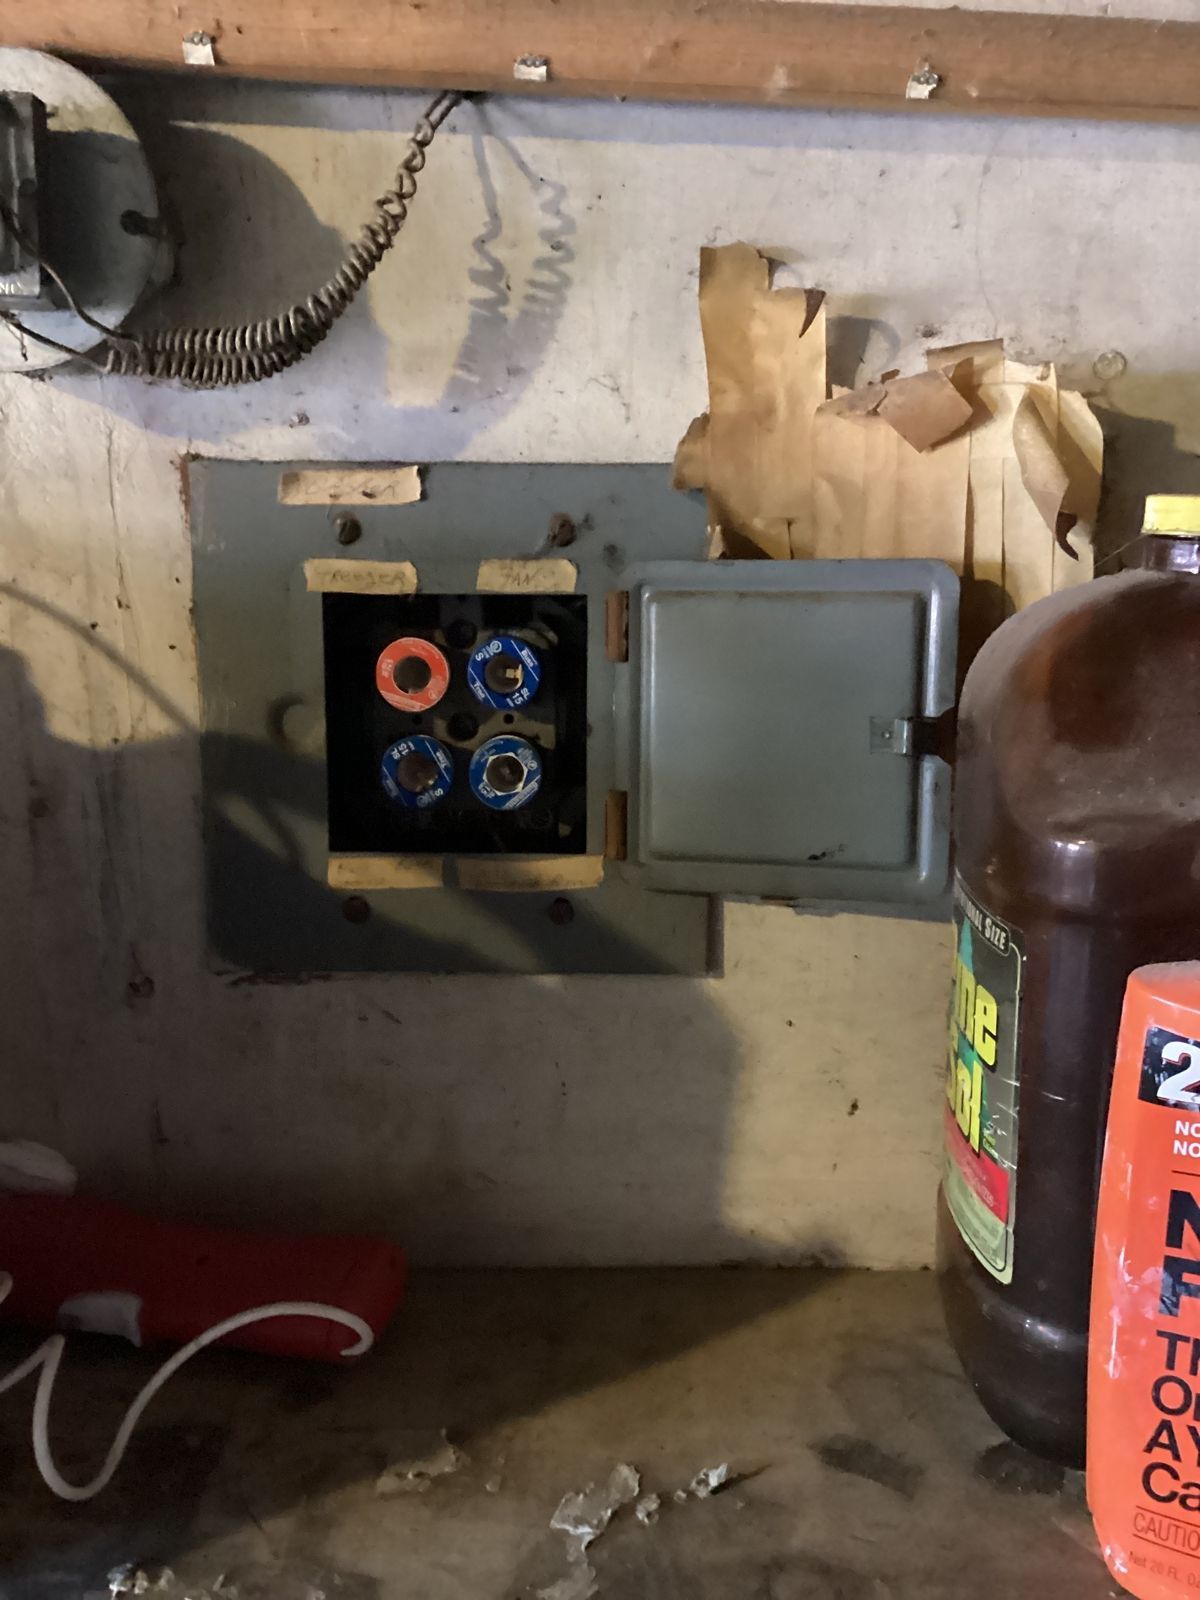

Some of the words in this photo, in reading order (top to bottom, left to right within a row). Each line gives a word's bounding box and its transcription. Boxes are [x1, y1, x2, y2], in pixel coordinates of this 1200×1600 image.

[984, 917, 1007, 951] SIZE
[1156, 1041, 1200, 1104] 2
[1172, 1139, 1200, 1159] NO
[1156, 1329, 1200, 1377] T
[1151, 1375, 1200, 1422] O
[1132, 1512, 1200, 1551] CAUTIO
